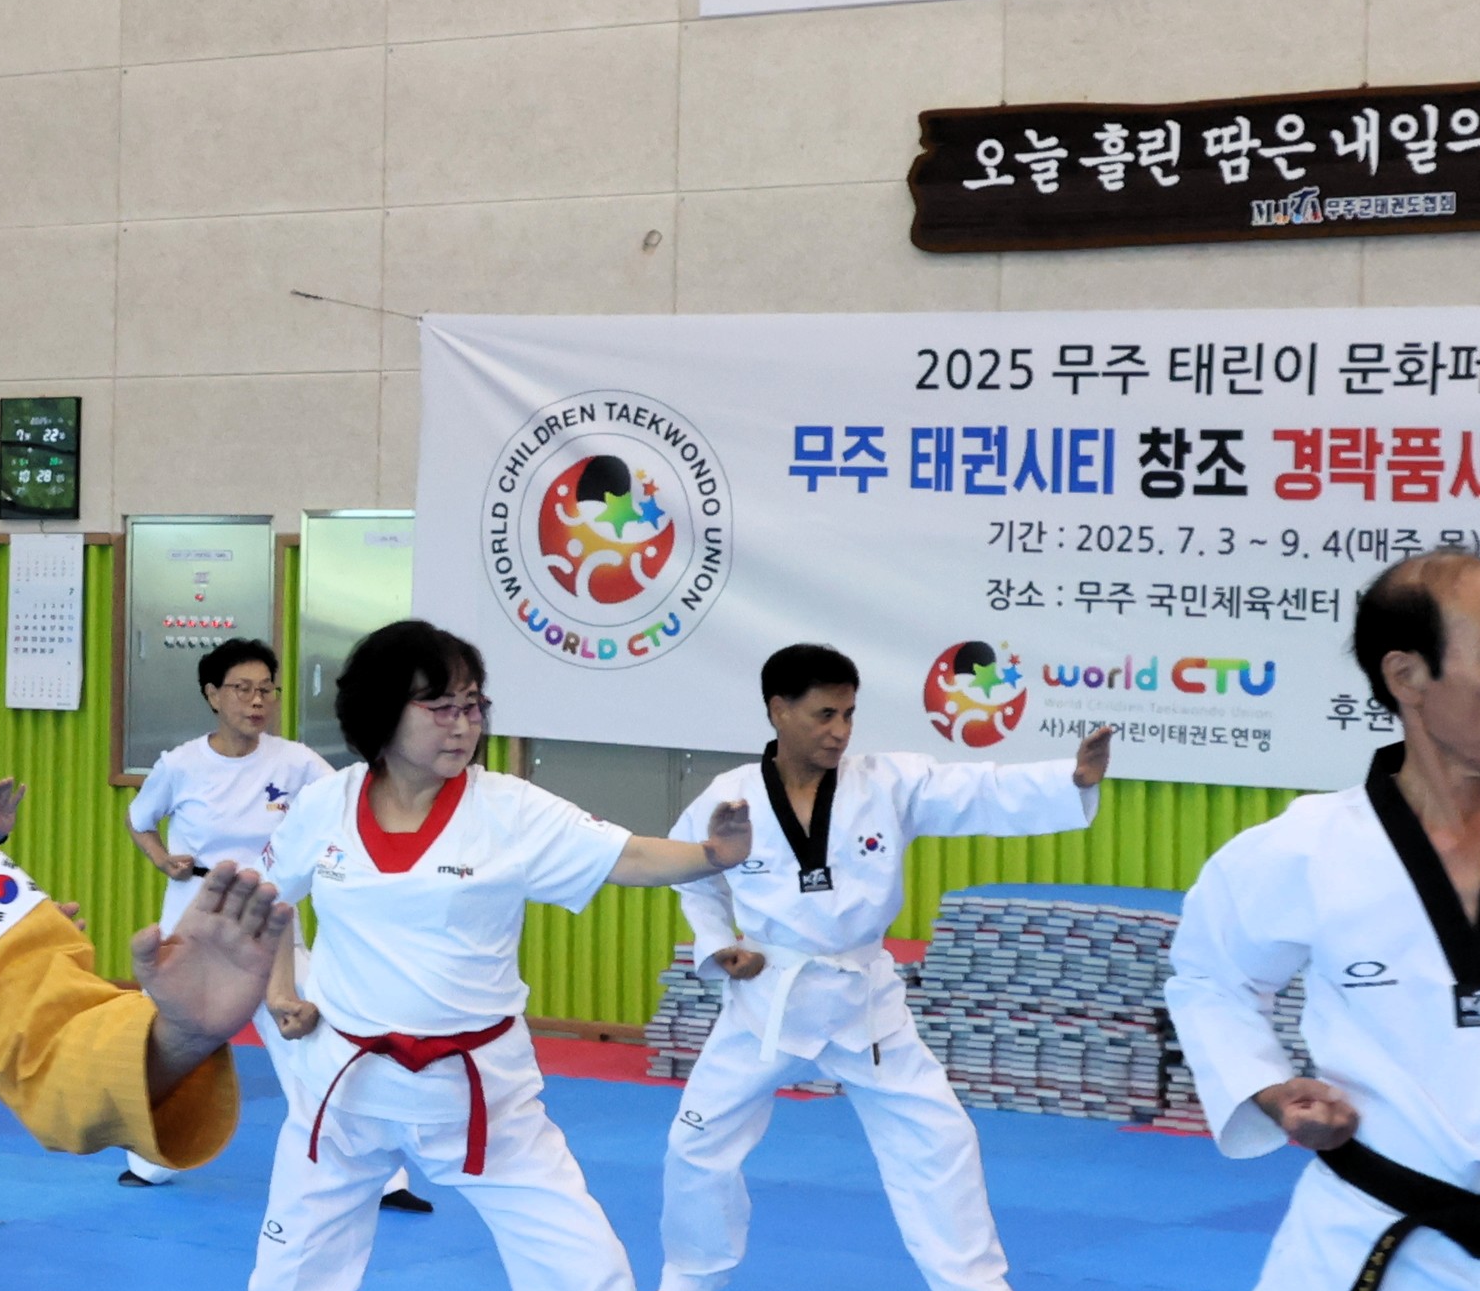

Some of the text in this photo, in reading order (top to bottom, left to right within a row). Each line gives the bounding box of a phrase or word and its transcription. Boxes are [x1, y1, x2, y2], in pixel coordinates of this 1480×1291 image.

[961, 128, 1069, 195] 오늘
[1078, 118, 1182, 193] 흘린
[1202, 113, 1317, 186] 땀은
[1325, 192, 1456, 220] 무주군태권도협회
[914, 347, 1035, 391] 2025
[1052, 343, 1150, 396] 무주
[1168, 342, 1318, 396] 태린이
[788, 424, 889, 493] 무주
[910, 424, 1116, 496] 태권시티
[1138, 425, 1248, 499] 창조
[491, 401, 723, 611] WORLD CHILDREN TAEKWONDO UNION
[987, 519, 1048, 554] 기간
[1076, 523, 1166, 556] 2025.
[1177, 526, 1206, 557] 7.
[1218, 526, 1236, 557] 3
[1281, 528, 1310, 560] 9.
[986, 578, 1046, 612] 장소
[1074, 580, 1137, 616] 무주
[1146, 583, 1341, 623] 국민체육센터
[627, 611, 681, 657] CTU
[1042, 653, 1276, 696] world CTU
